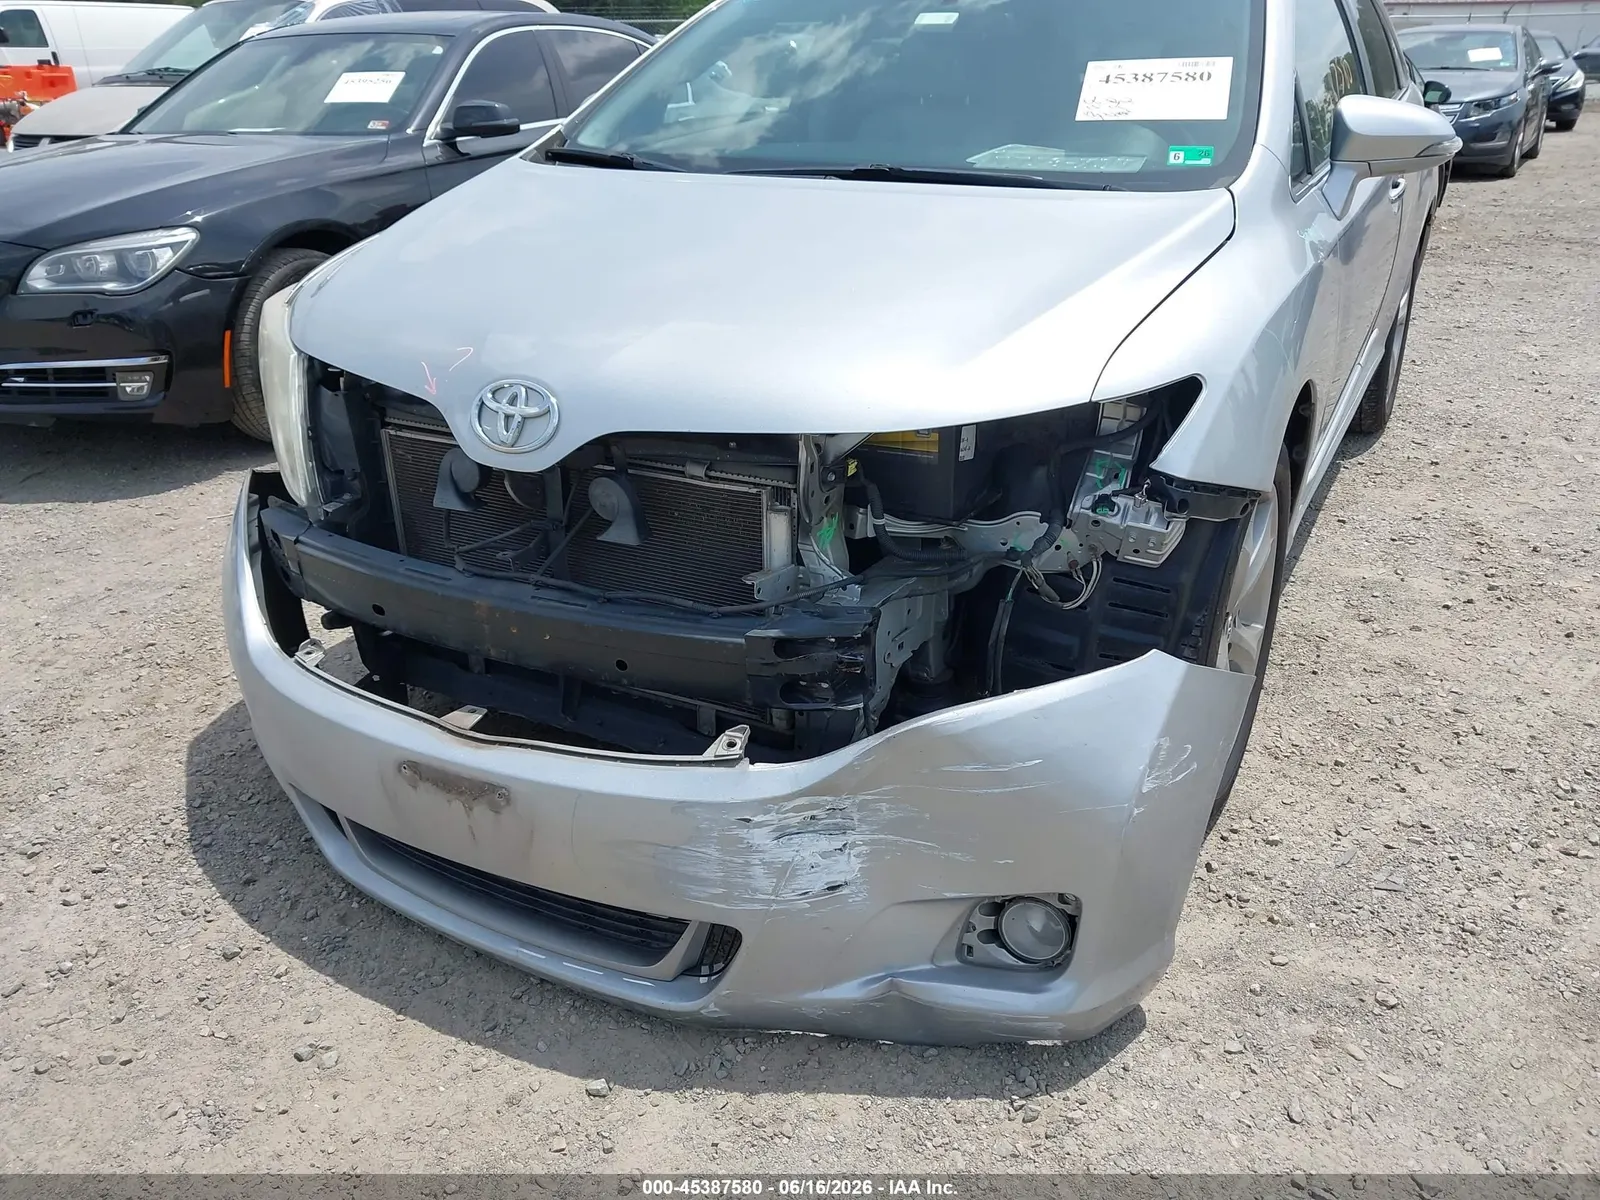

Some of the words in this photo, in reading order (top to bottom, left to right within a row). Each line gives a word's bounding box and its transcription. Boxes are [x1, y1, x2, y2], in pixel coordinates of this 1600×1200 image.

[1098, 71, 1213, 85] 45387580
[1173, 152, 1181, 161] 6
[1198, 149, 1210, 157] 26
